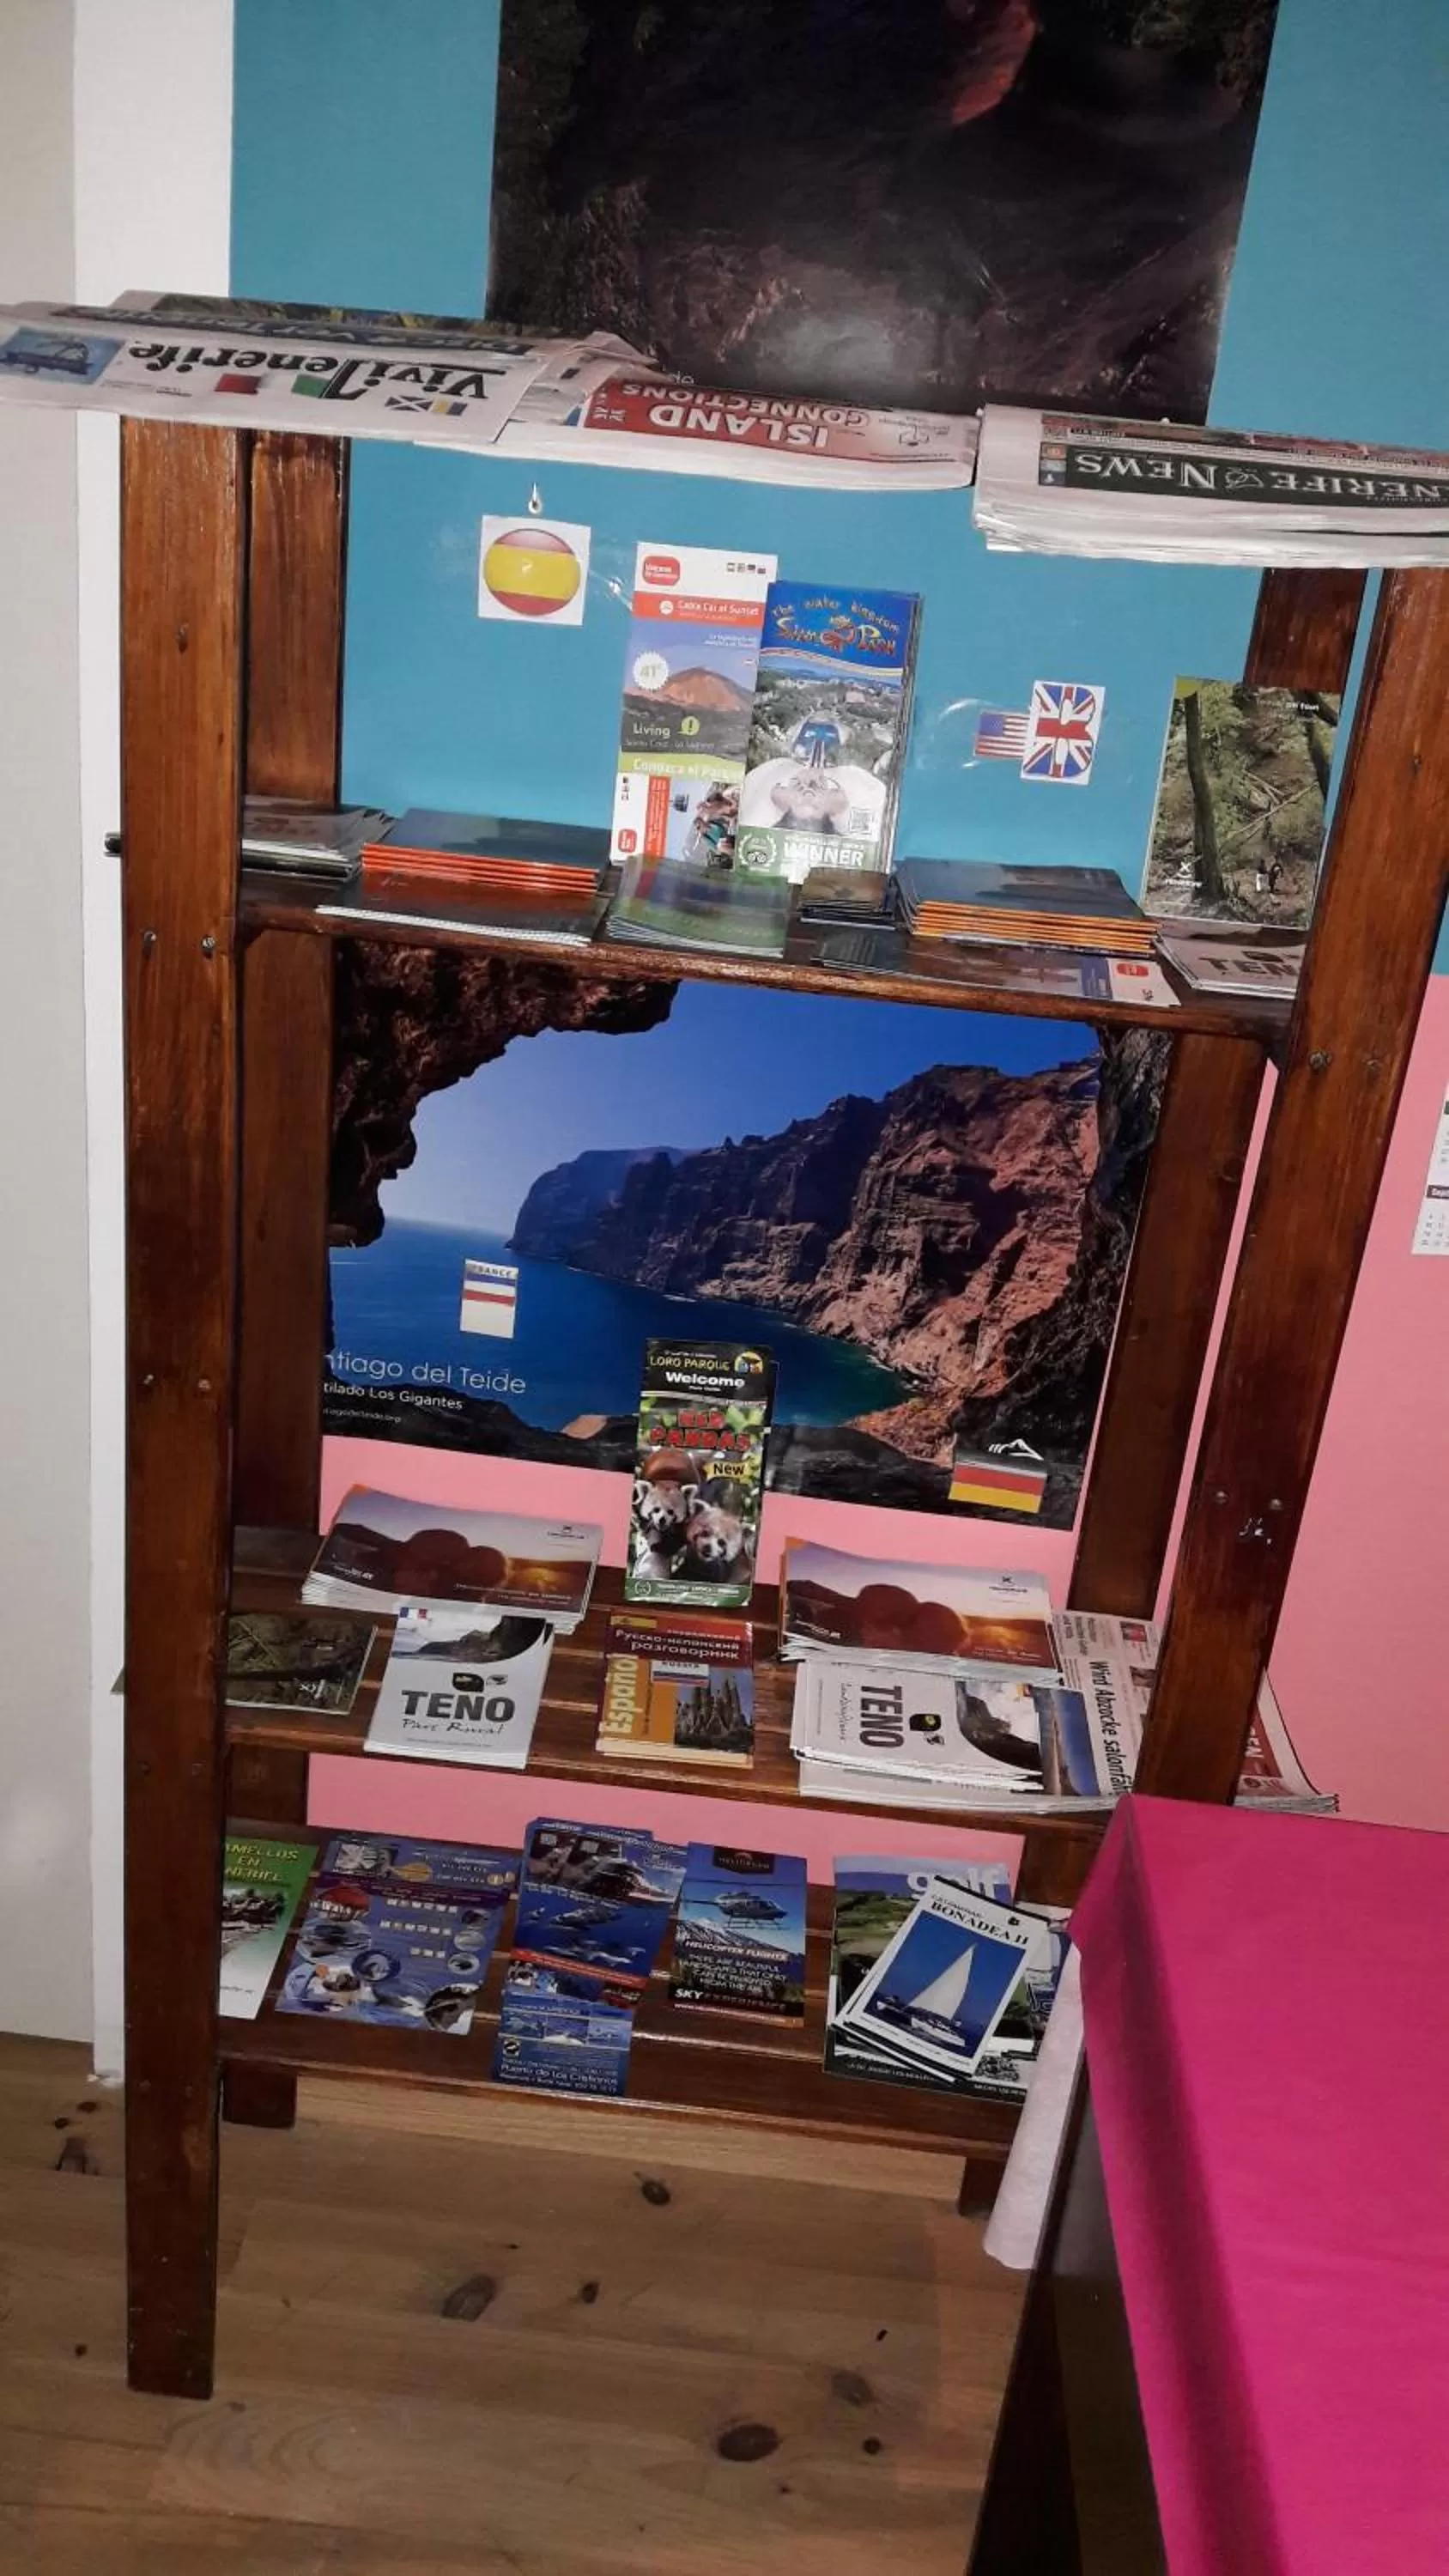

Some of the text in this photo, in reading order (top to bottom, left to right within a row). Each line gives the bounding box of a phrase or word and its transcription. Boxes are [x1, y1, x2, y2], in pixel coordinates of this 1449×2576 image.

[621, 383, 870, 428] CONNECTIONS
[648, 403, 829, 448] ISLAND
[1270, 469, 1449, 500] NERIFE
[632, 722, 671, 739] Living
[783, 841, 864, 867] WINNER
[470, 1262, 514, 1279] FRANCE
[649, 1356, 731, 1371] LORO PARQUE
[410, 1363, 452, 1385] del
[459, 1365, 526, 1395] Teide
[664, 1371, 746, 1388] Welcome
[369, 1387, 396, 1401] Los
[398, 1389, 464, 1411] Gigantes
[649, 1425, 752, 1453] PANDAS
[712, 1462, 746, 1480] New
[1088, 1661, 1113, 1690] Wird
[400, 1689, 515, 1723] TENO
[599, 1652, 643, 1735] Español
[858, 1685, 905, 1749] TENO
[1094, 1689, 1124, 1737] Abzocke
[906, 1863, 1008, 1901] glf
[685, 1941, 743, 1954] HELICOPTER
[675, 1988, 704, 2000] SKY
